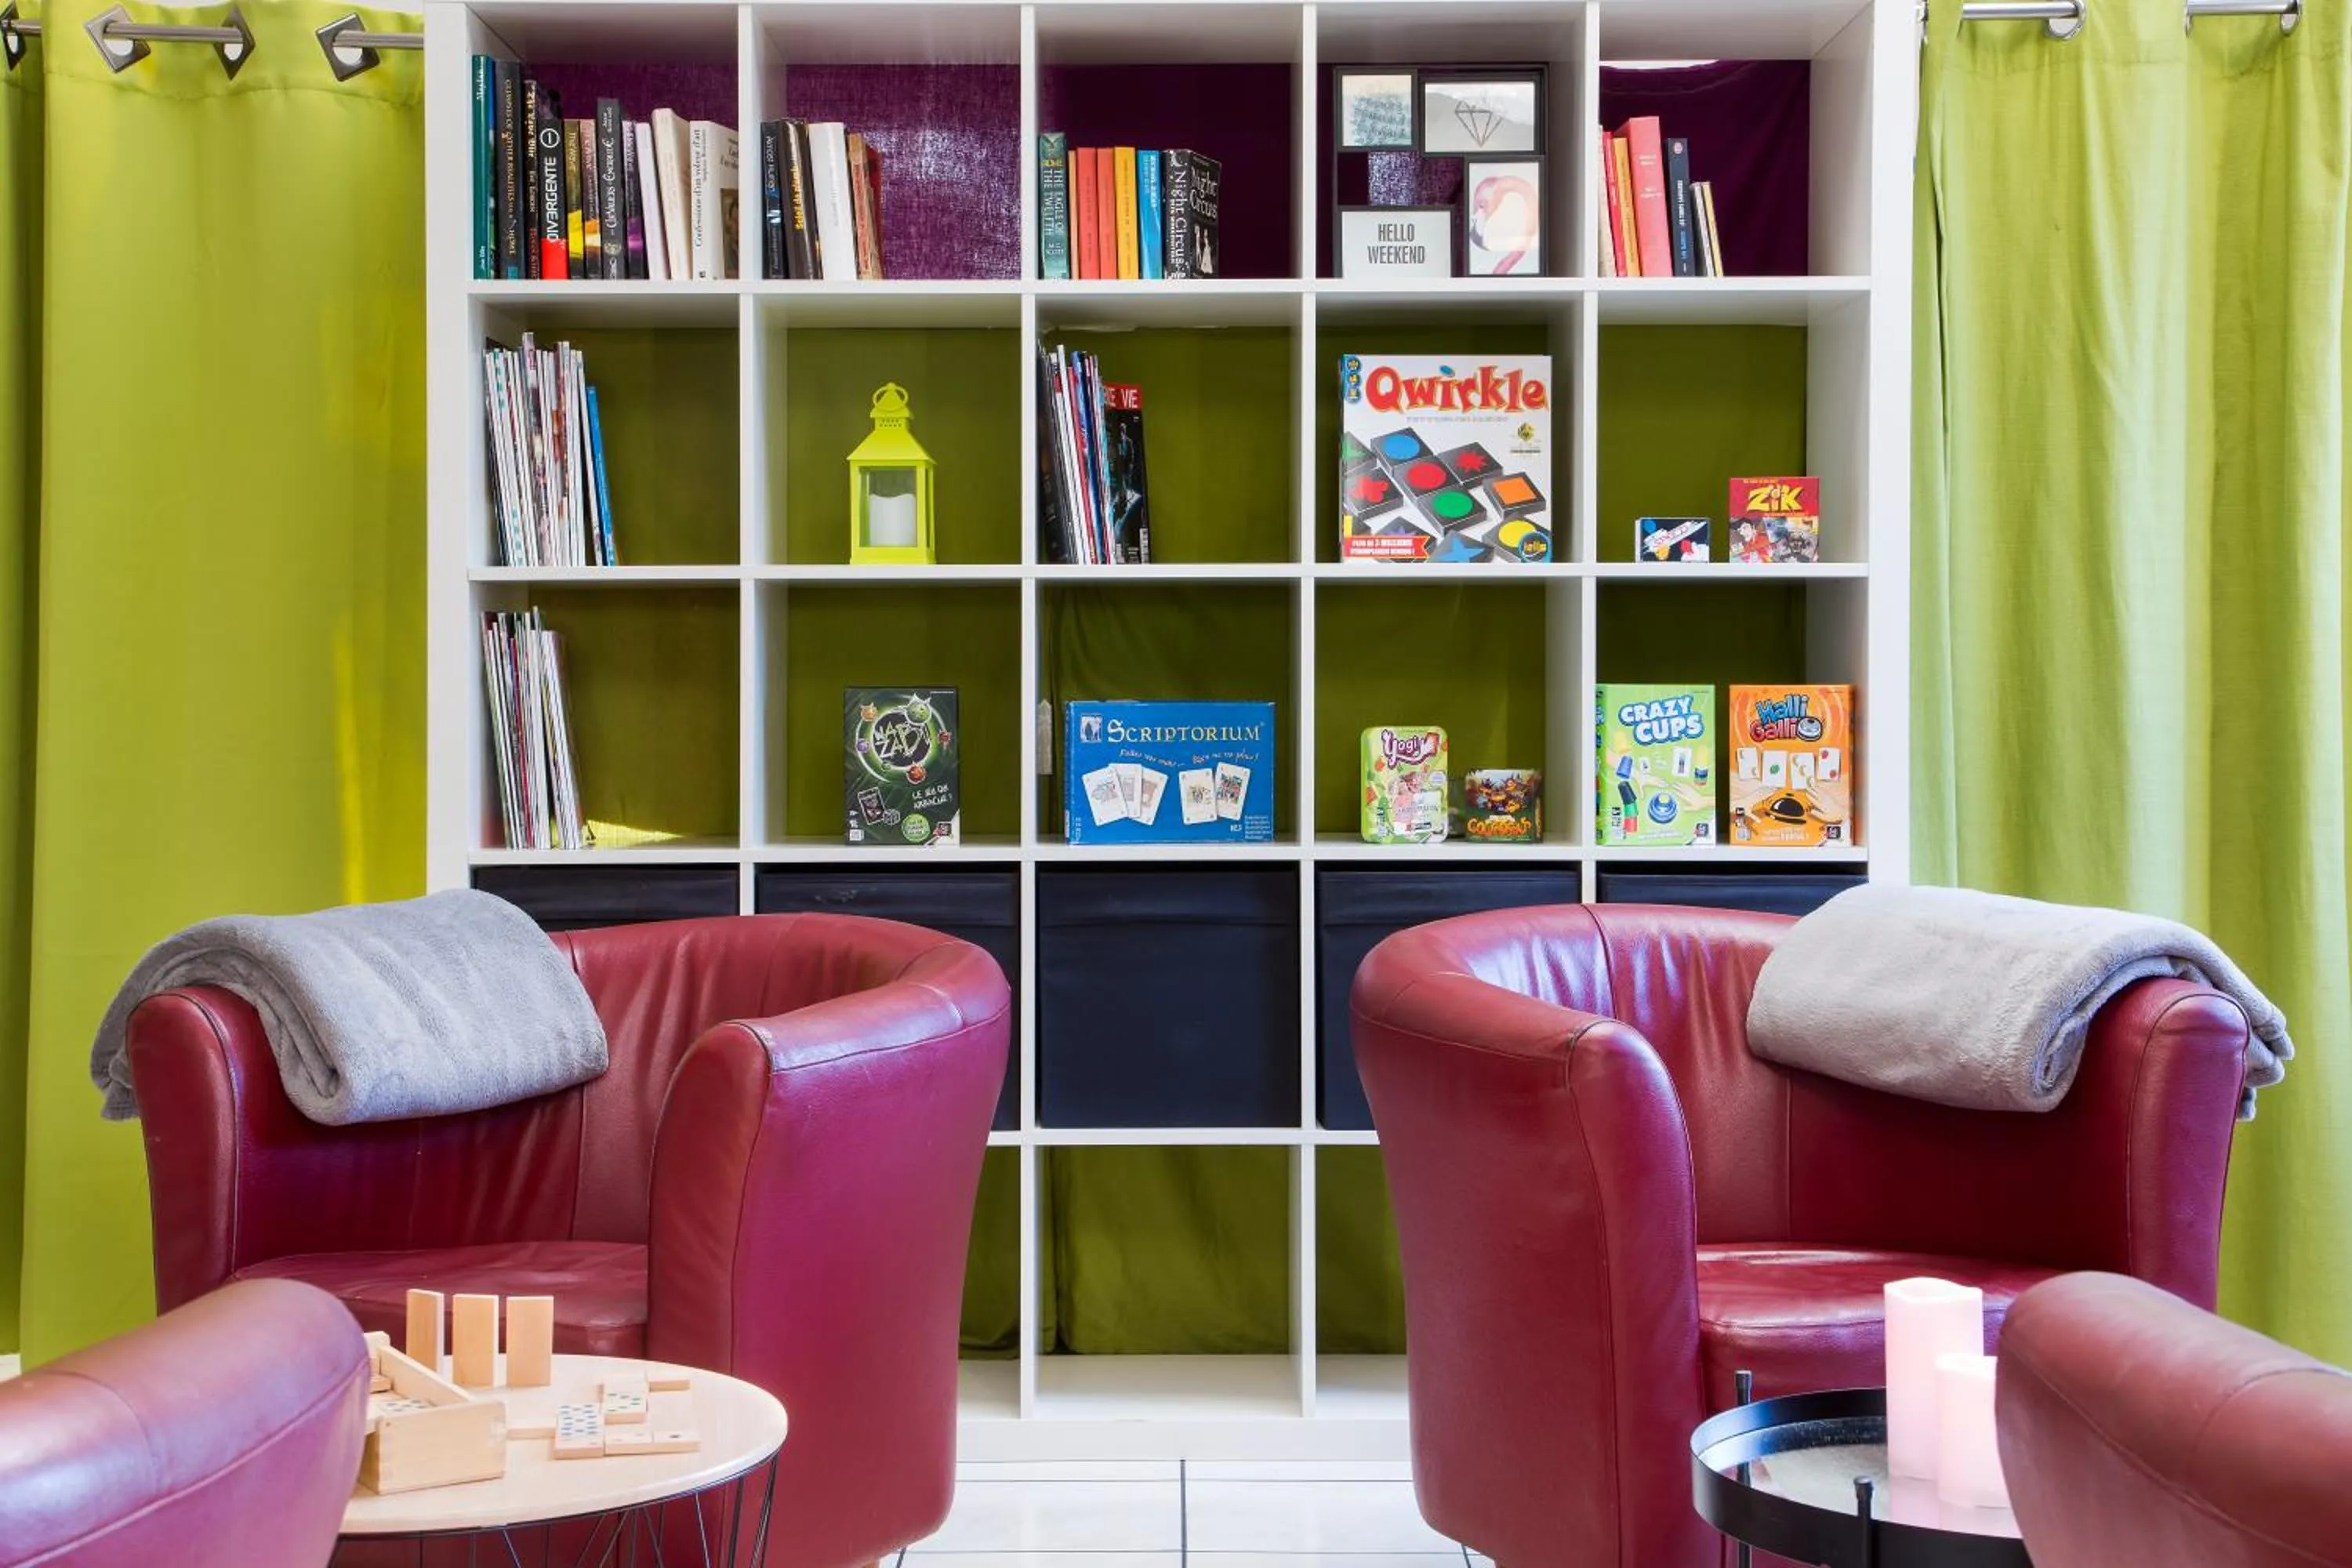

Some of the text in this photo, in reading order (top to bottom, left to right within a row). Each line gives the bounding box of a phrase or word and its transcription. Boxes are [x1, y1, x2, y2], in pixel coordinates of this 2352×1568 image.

[1172, 171, 1188, 264] Night Circus
[1377, 223, 1415, 242] HELLO
[1367, 245, 1425, 264] WEEKEND
[1120, 388, 1138, 408] VIE
[1365, 365, 1548, 413] Qwirkle
[1619, 695, 1693, 724] CRAZY
[1755, 693, 1809, 725] Halli
[1107, 719, 1261, 742] SCRIPTORIUM
[1634, 713, 1704, 744] CUPS
[1749, 718, 1801, 742] Galli
